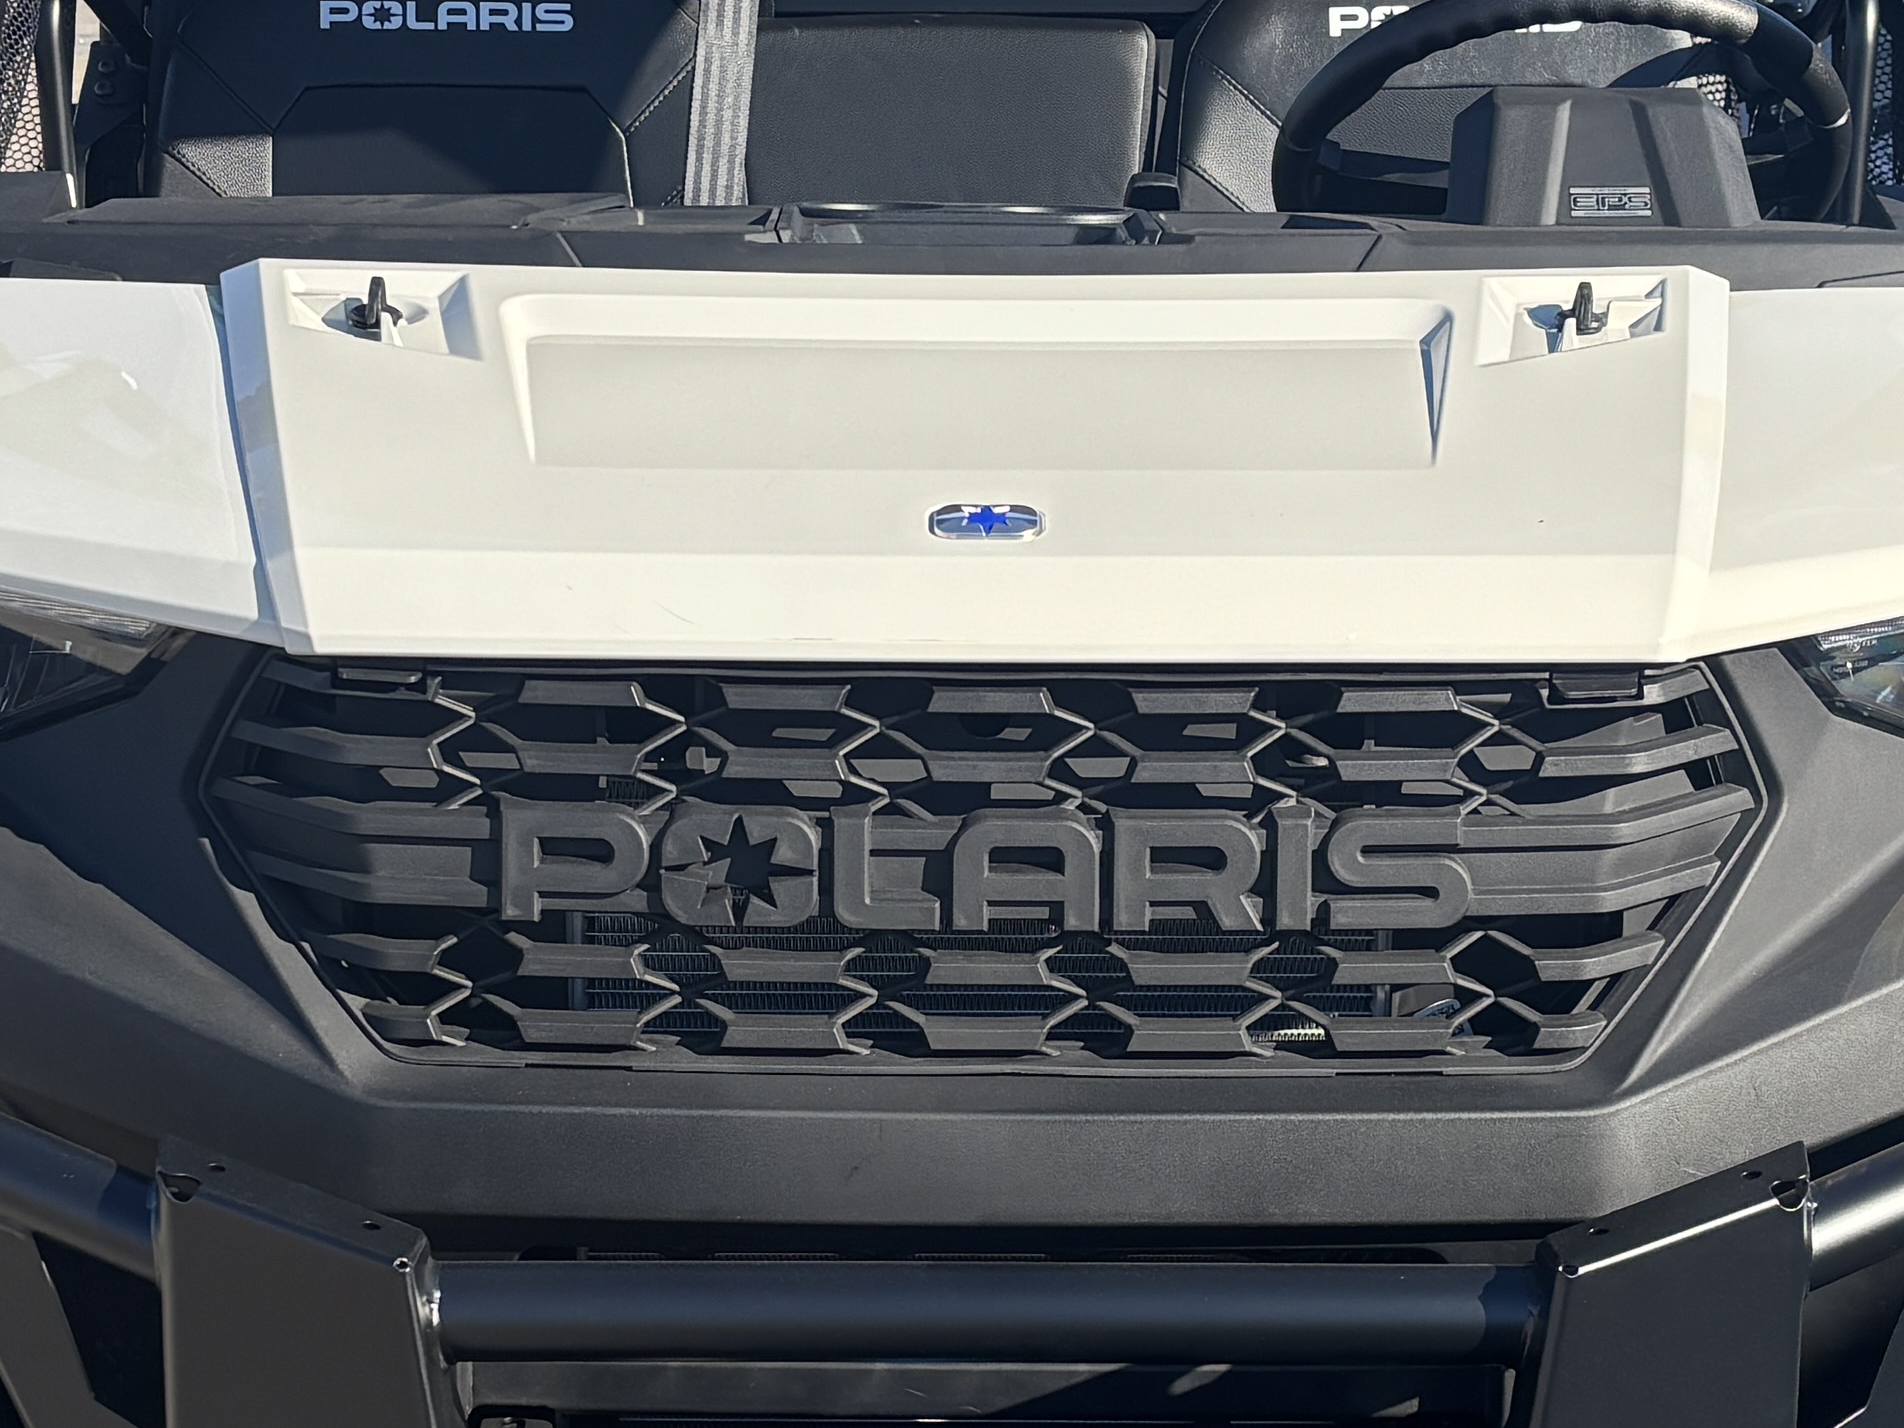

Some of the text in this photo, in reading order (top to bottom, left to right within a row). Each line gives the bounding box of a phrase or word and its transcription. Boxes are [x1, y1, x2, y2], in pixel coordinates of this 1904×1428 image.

[318, 0, 575, 33] POLARIS
[1570, 193, 1652, 210] EPS
[498, 801, 1472, 932] POLARIS
